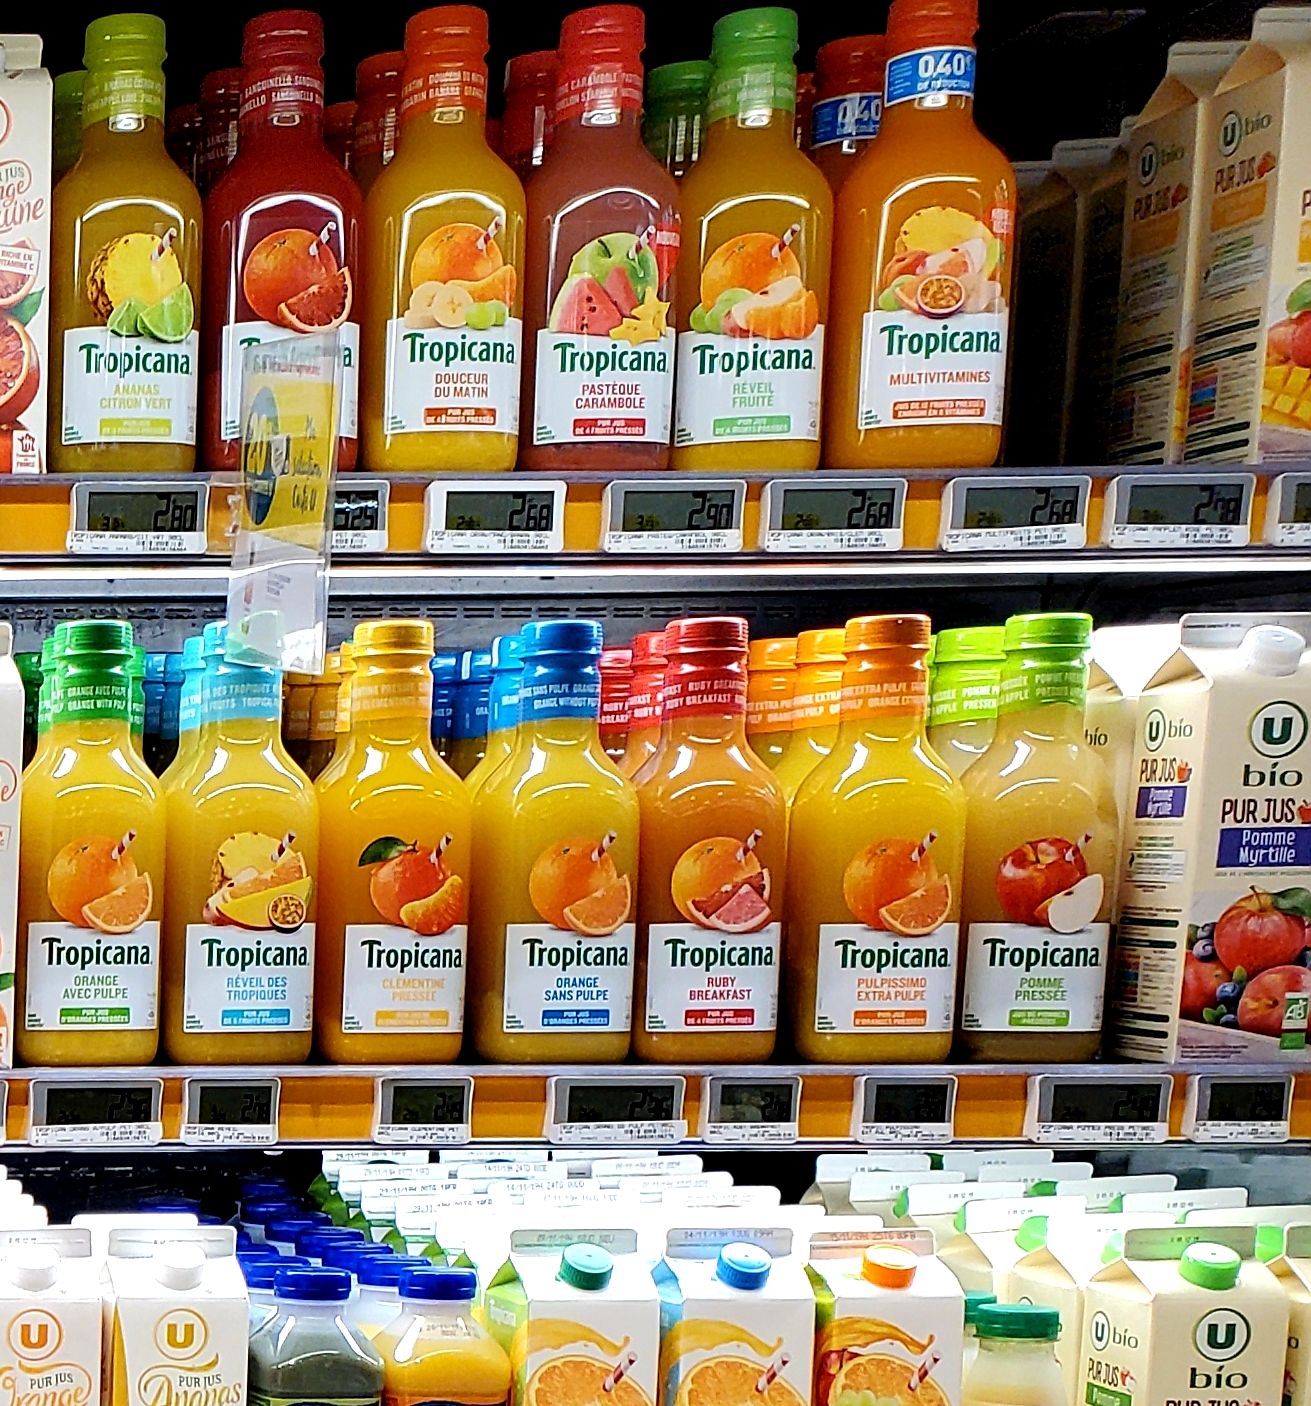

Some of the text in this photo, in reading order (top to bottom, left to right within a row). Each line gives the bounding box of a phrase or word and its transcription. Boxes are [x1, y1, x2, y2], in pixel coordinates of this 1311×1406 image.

[4, 167, 24, 183] JUS
[403, 333, 516, 366] Tropicana
[880, 326, 1002, 358] Tropicana
[79, 343, 192, 377] Tropicana
[554, 343, 669, 375] Tropicana
[435, 373, 488, 385] DOUCEUR
[889, 371, 991, 387] MULTIVITAMINES
[113, 384, 160, 396] ANANAS
[434, 386, 488, 398] DU MATIN
[581, 381, 641, 398] PASTÈQUE
[100, 397, 172, 410] CITRON VERT
[575, 397, 646, 410] CARAMBOLE
[1221, 798, 1296, 824] PUR JUS
[1242, 830, 1295, 848] Pomme
[1240, 845, 1295, 865] Myrtille
[42, 938, 152, 967] Tropicana
[201, 940, 309, 968] Tropicana
[522, 938, 629, 969] Tropicana
[983, 940, 1101, 970] Tropicana
[857, 978, 927, 989] PULPISSIMO
[63, 987, 128, 1000] AVEC PULPE
[226, 988, 286, 1003] TROPIQUES
[689, 989, 752, 1001] BREAKFAST
